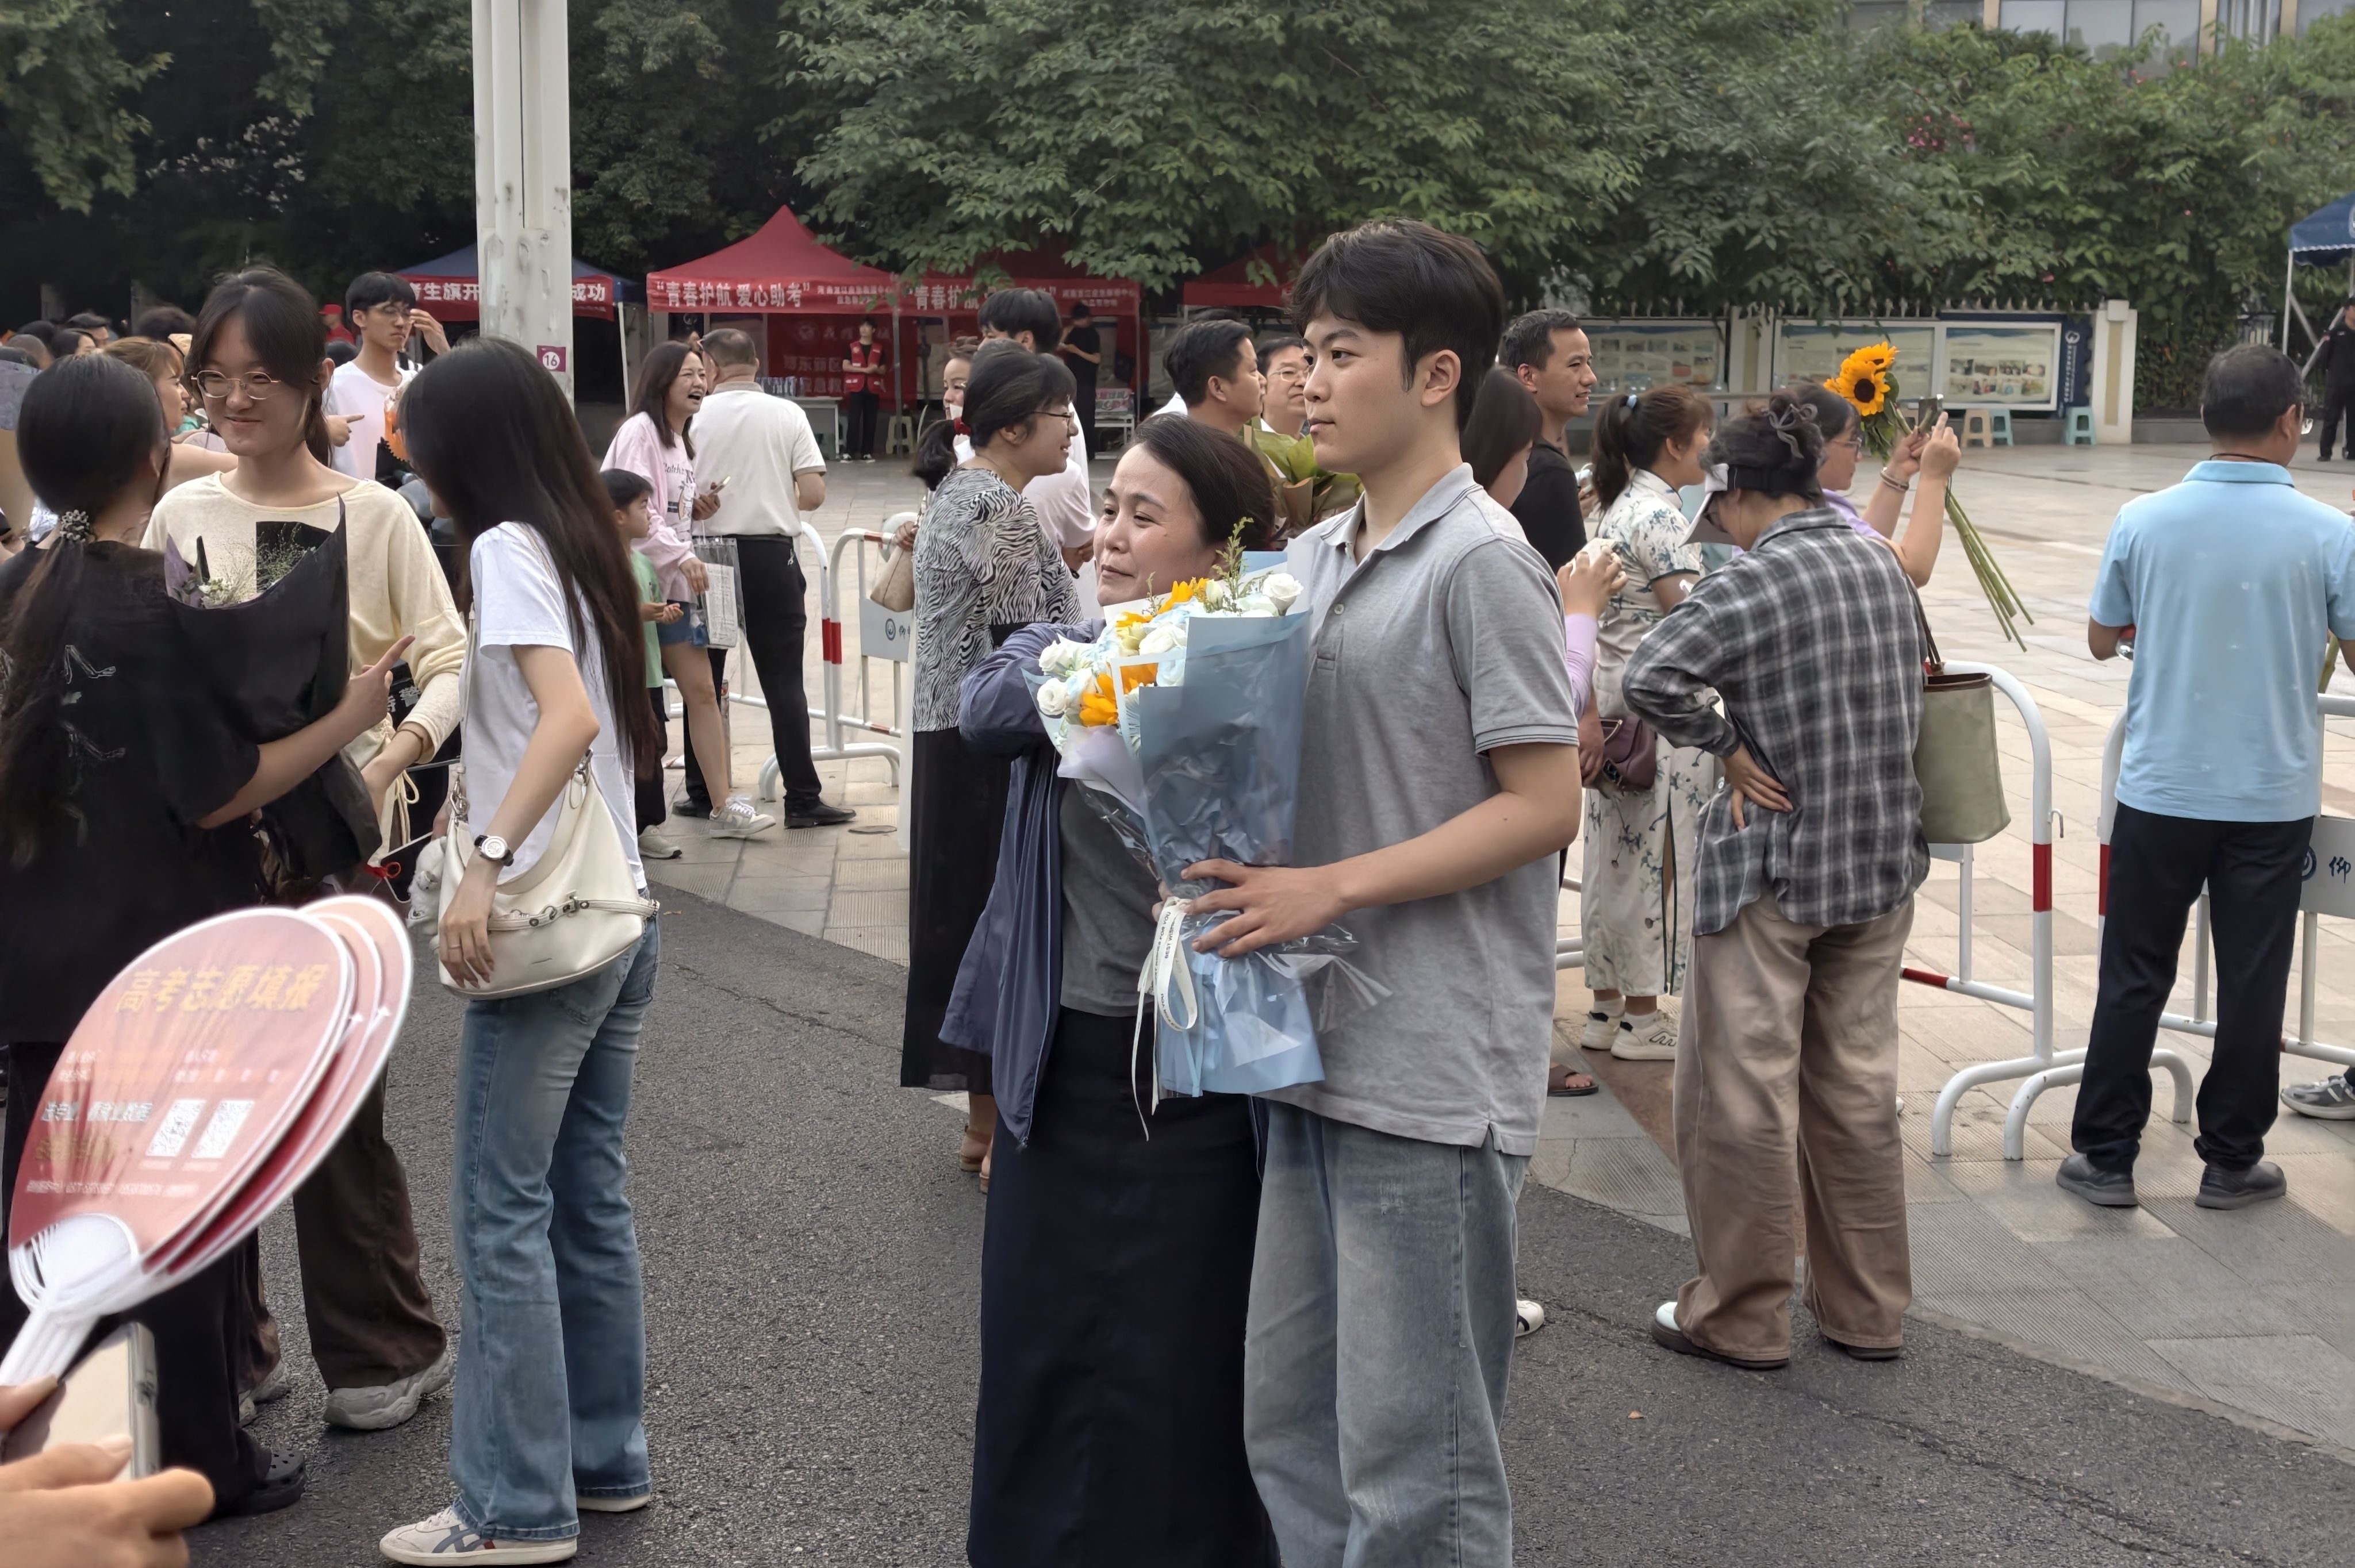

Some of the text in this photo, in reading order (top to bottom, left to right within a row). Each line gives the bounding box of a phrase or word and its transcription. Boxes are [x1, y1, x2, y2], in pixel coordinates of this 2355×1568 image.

[572, 283, 605, 301] 成功
[544, 355, 558, 366] 16
[1163, 911, 1171, 925] YOU
[116, 963, 330, 1013] 高考志愿填报
